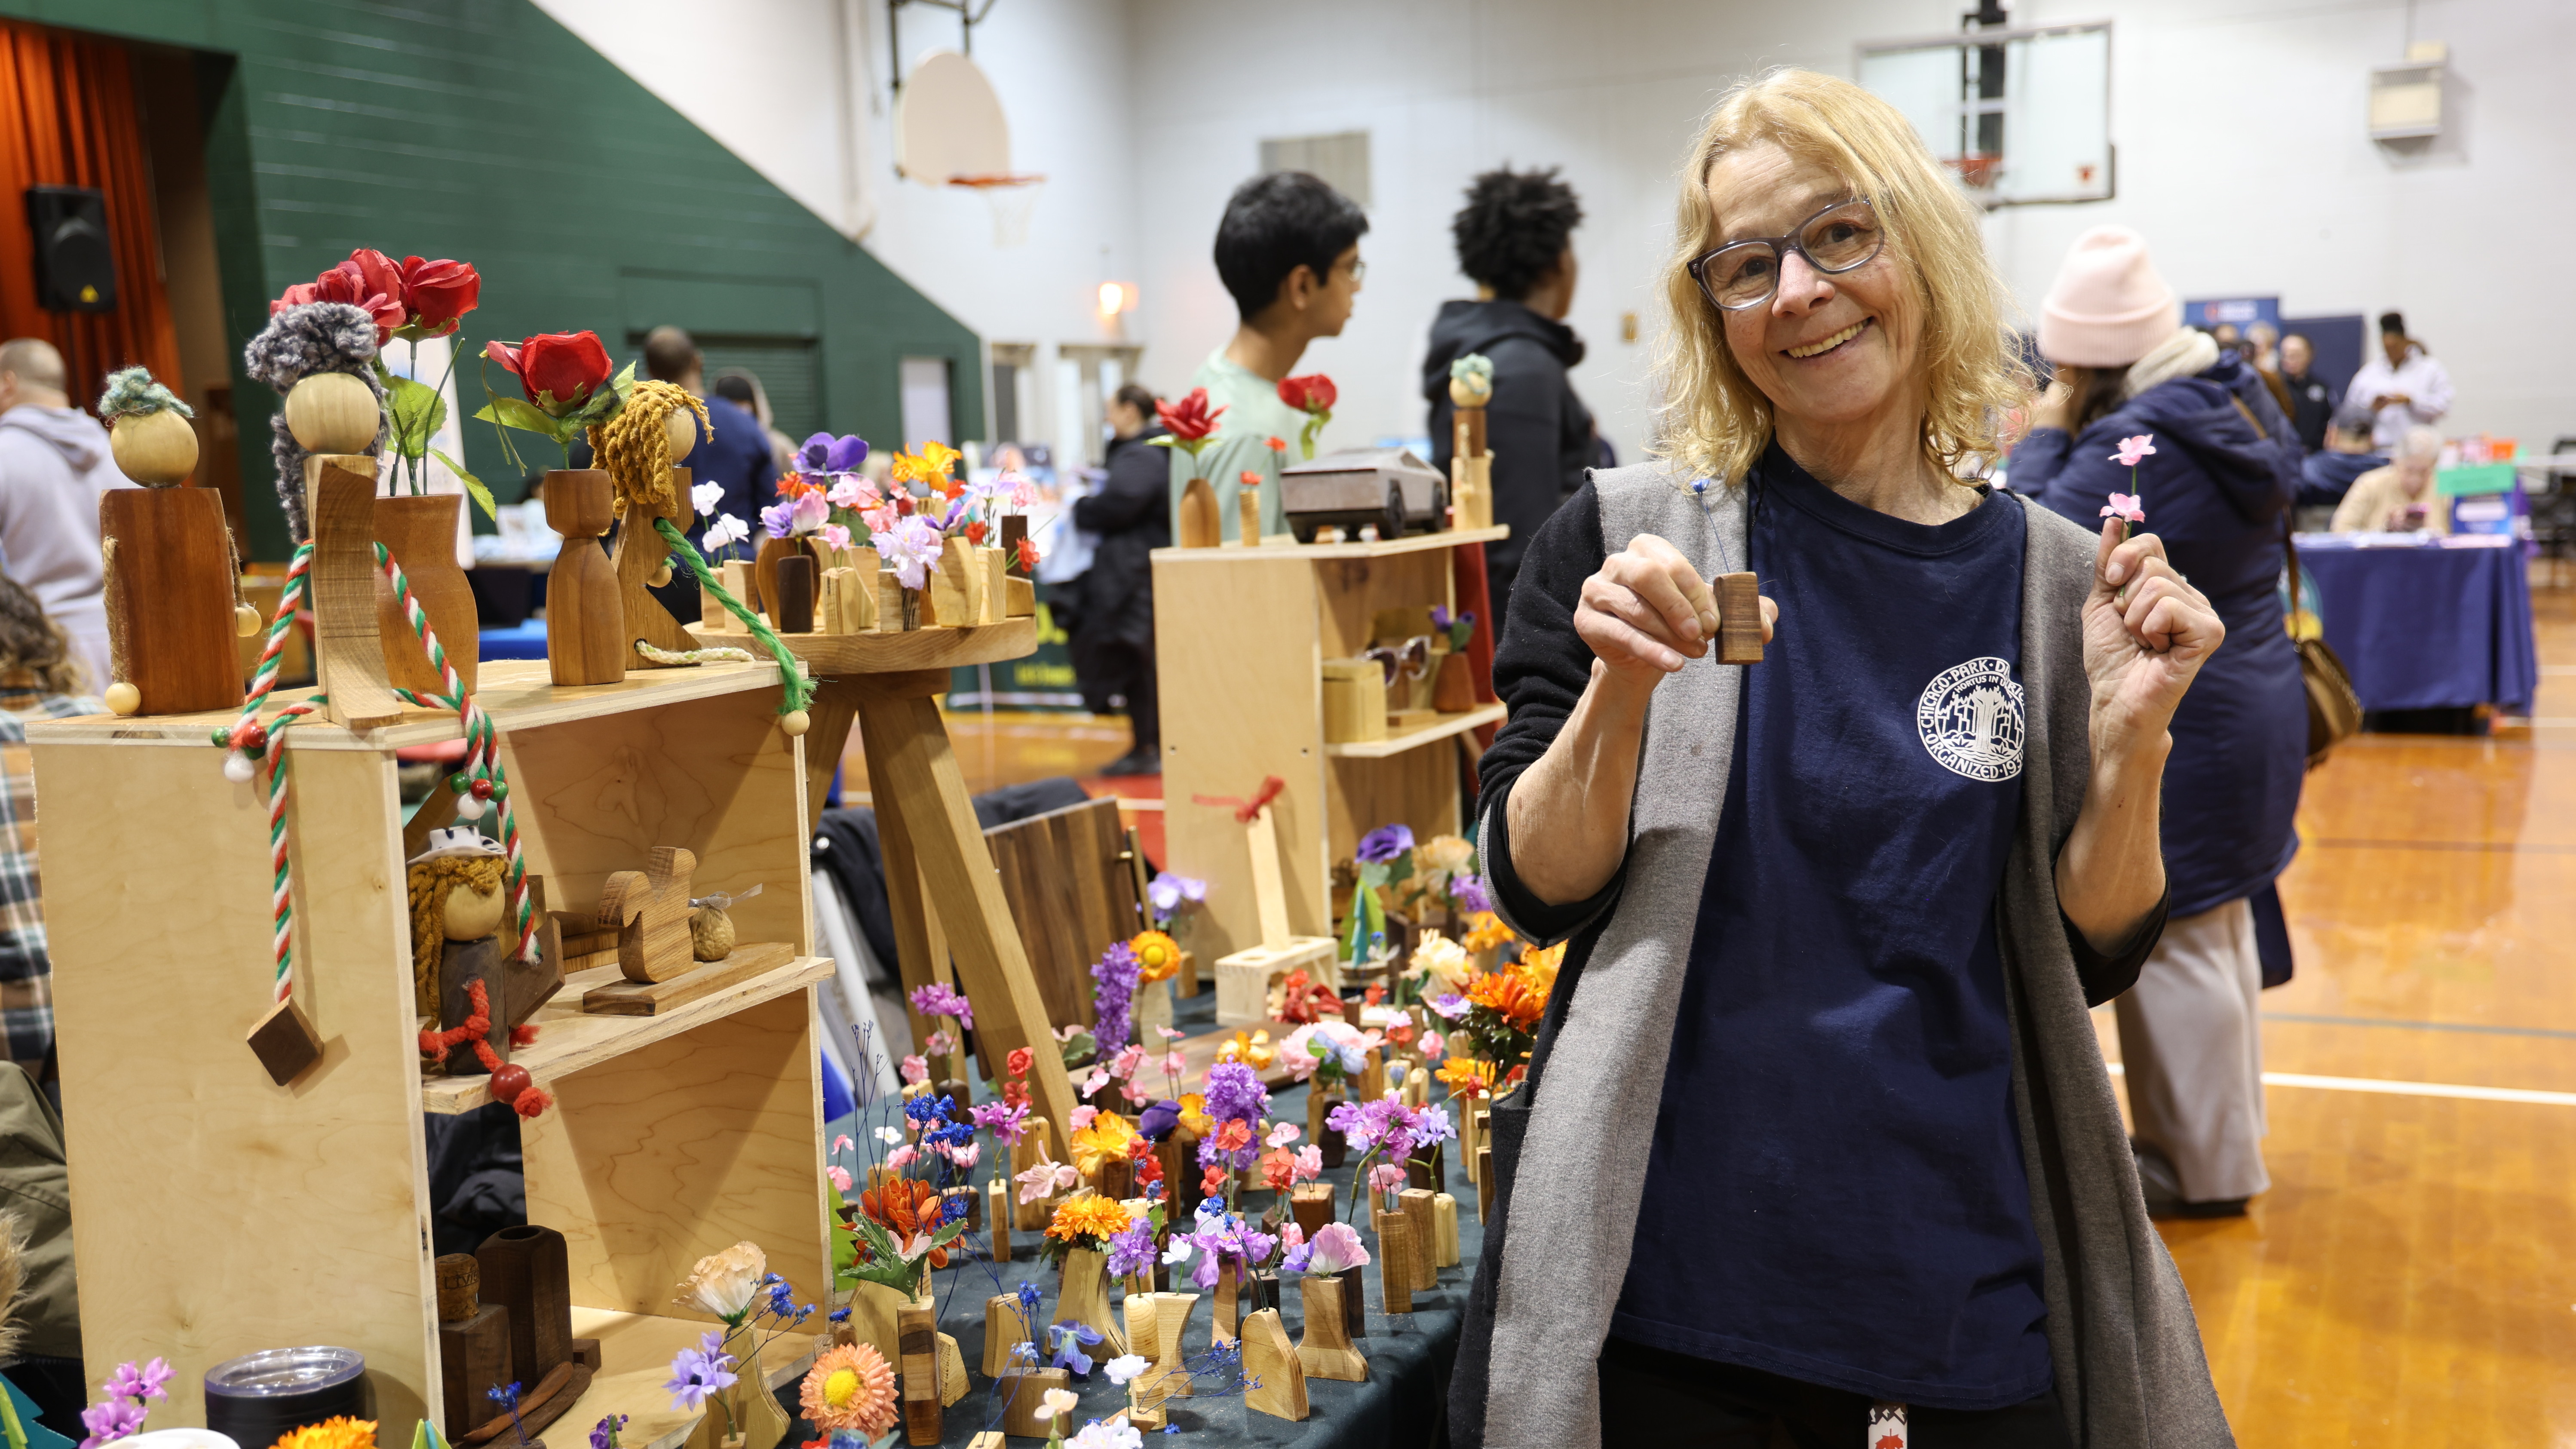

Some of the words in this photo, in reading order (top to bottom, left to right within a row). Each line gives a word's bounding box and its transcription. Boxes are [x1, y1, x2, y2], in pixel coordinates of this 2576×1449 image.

[1920, 677, 1950, 728] CHICAGO
[1950, 659, 1989, 682] PARK
[1954, 675, 1987, 693] HORTUS
[1988, 675, 1999, 684] IN
[1925, 734, 1999, 779] ORGANIZED
